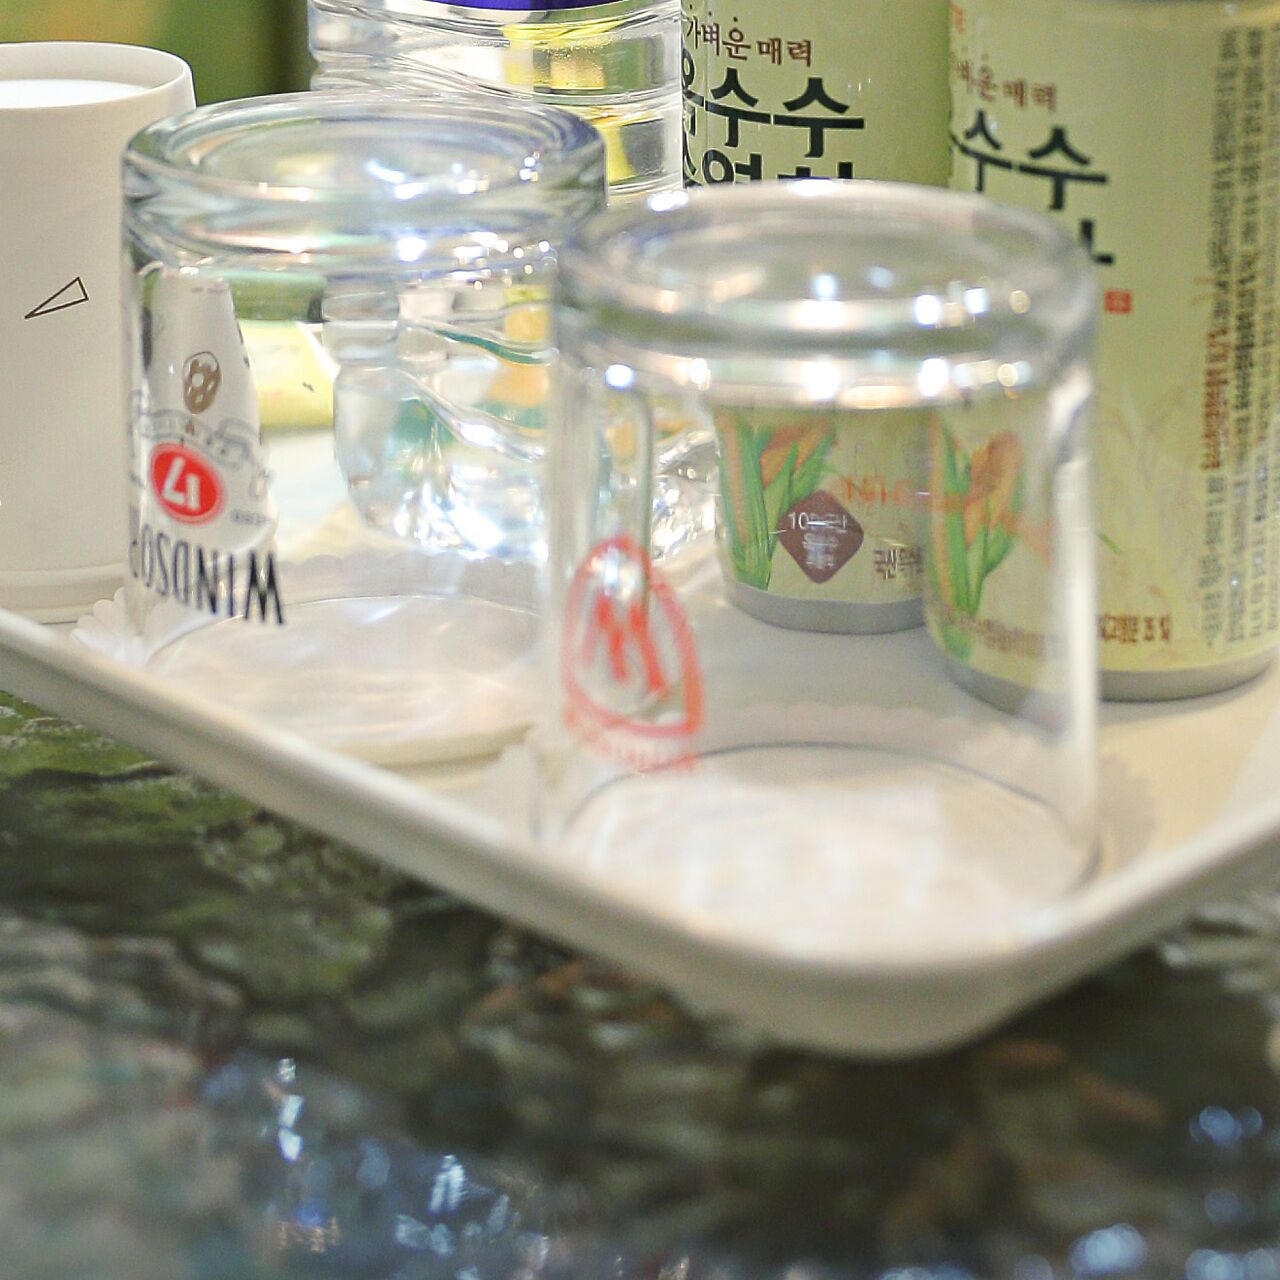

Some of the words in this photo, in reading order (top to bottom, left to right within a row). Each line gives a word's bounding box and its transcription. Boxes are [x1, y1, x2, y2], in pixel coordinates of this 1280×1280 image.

[686, 15, 752, 61] 가벼운
[757, 37, 812, 68] 매력
[950, 108, 1109, 211] 수수
